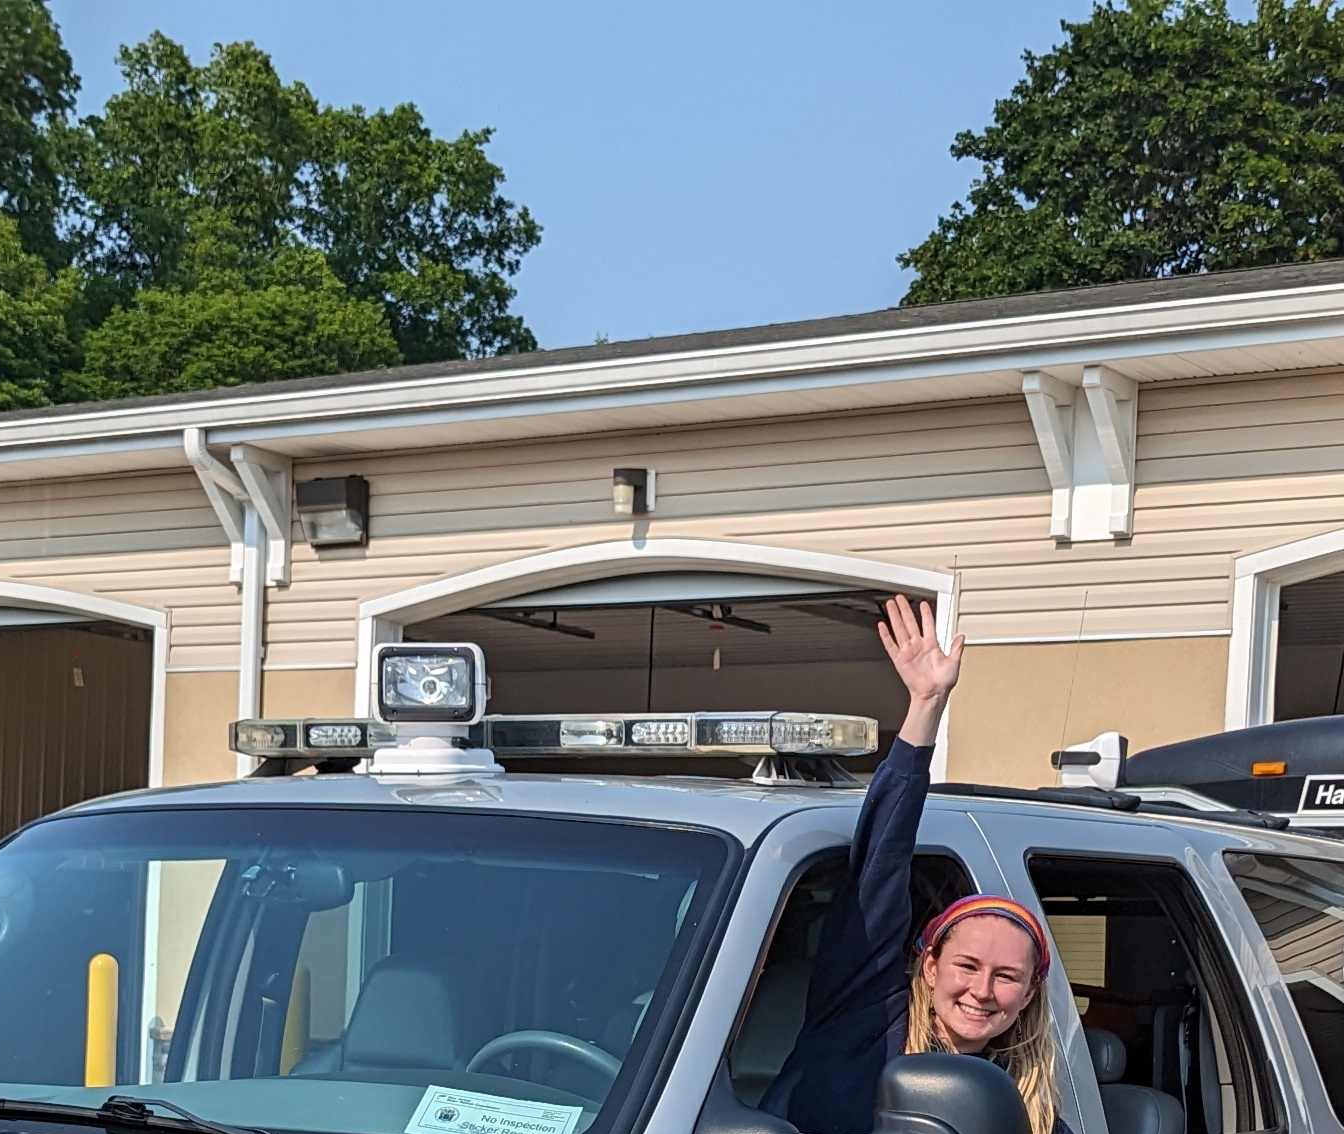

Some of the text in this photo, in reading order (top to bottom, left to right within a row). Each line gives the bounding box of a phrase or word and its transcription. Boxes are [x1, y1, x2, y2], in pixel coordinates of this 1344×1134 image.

[460, 1121, 498, 1134] Sticker
[480, 1114, 498, 1124] No
[499, 1117, 557, 1134] Inspection
